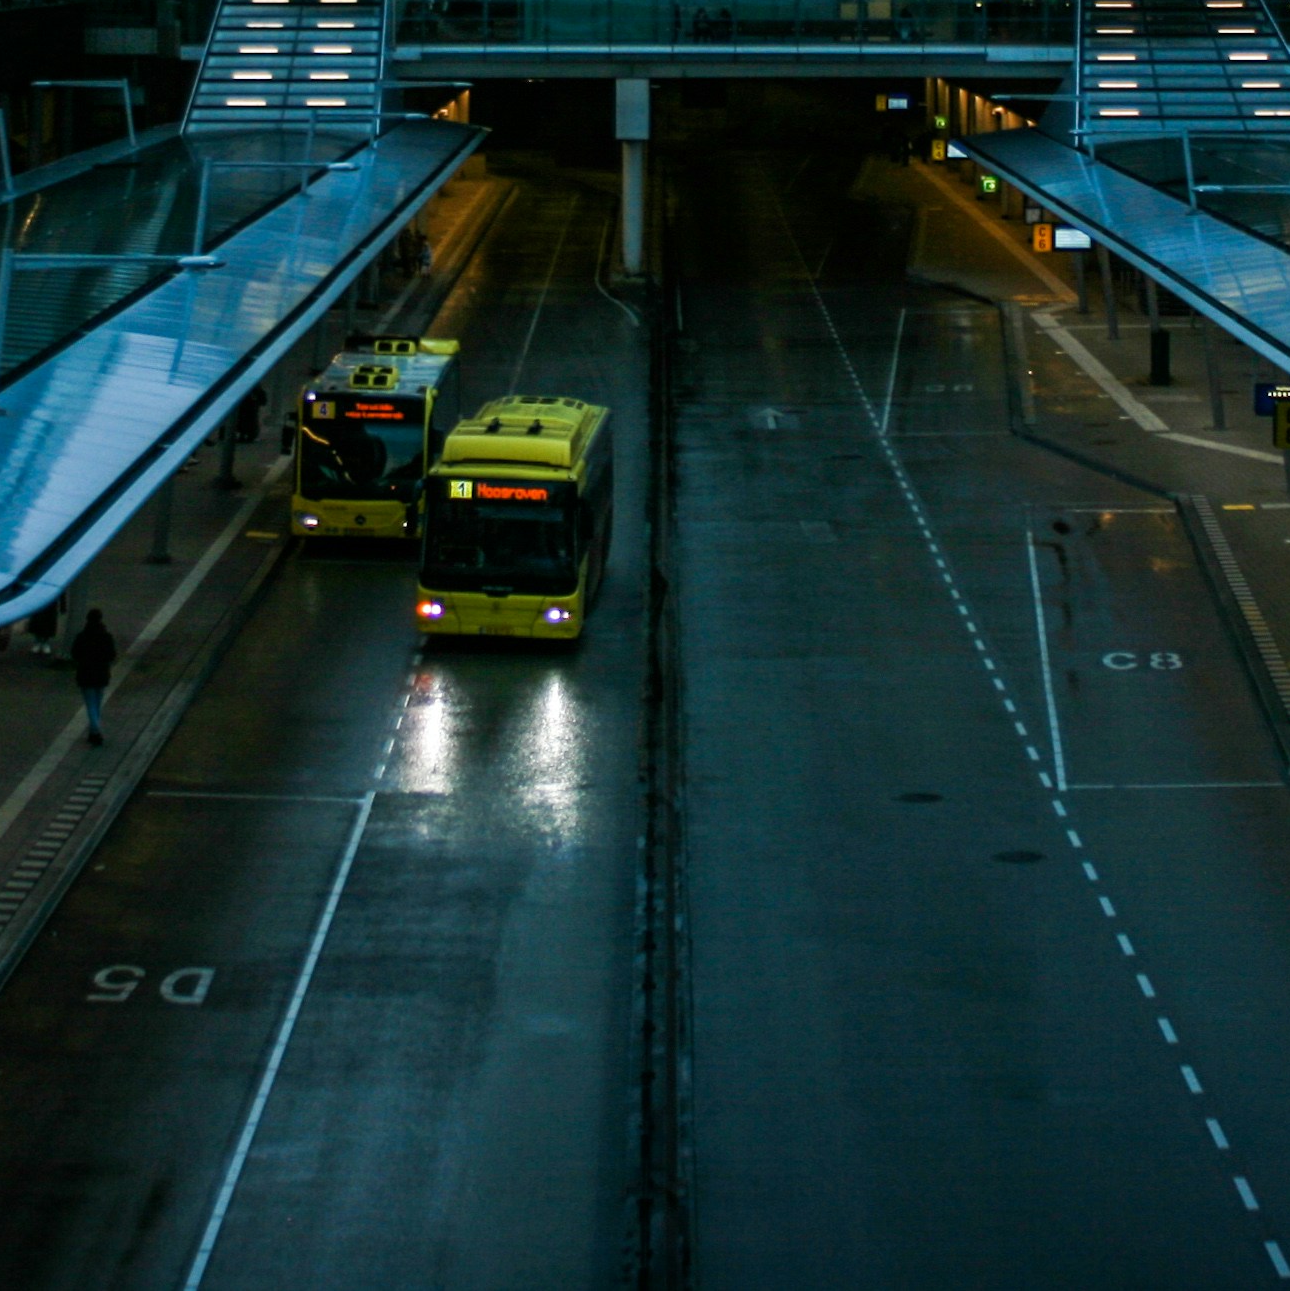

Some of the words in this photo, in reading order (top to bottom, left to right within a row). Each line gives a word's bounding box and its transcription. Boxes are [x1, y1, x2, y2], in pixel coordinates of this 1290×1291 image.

[458, 482, 465, 498] 1
[1102, 652, 1183, 670] C8
[86, 964, 217, 1004] D5
